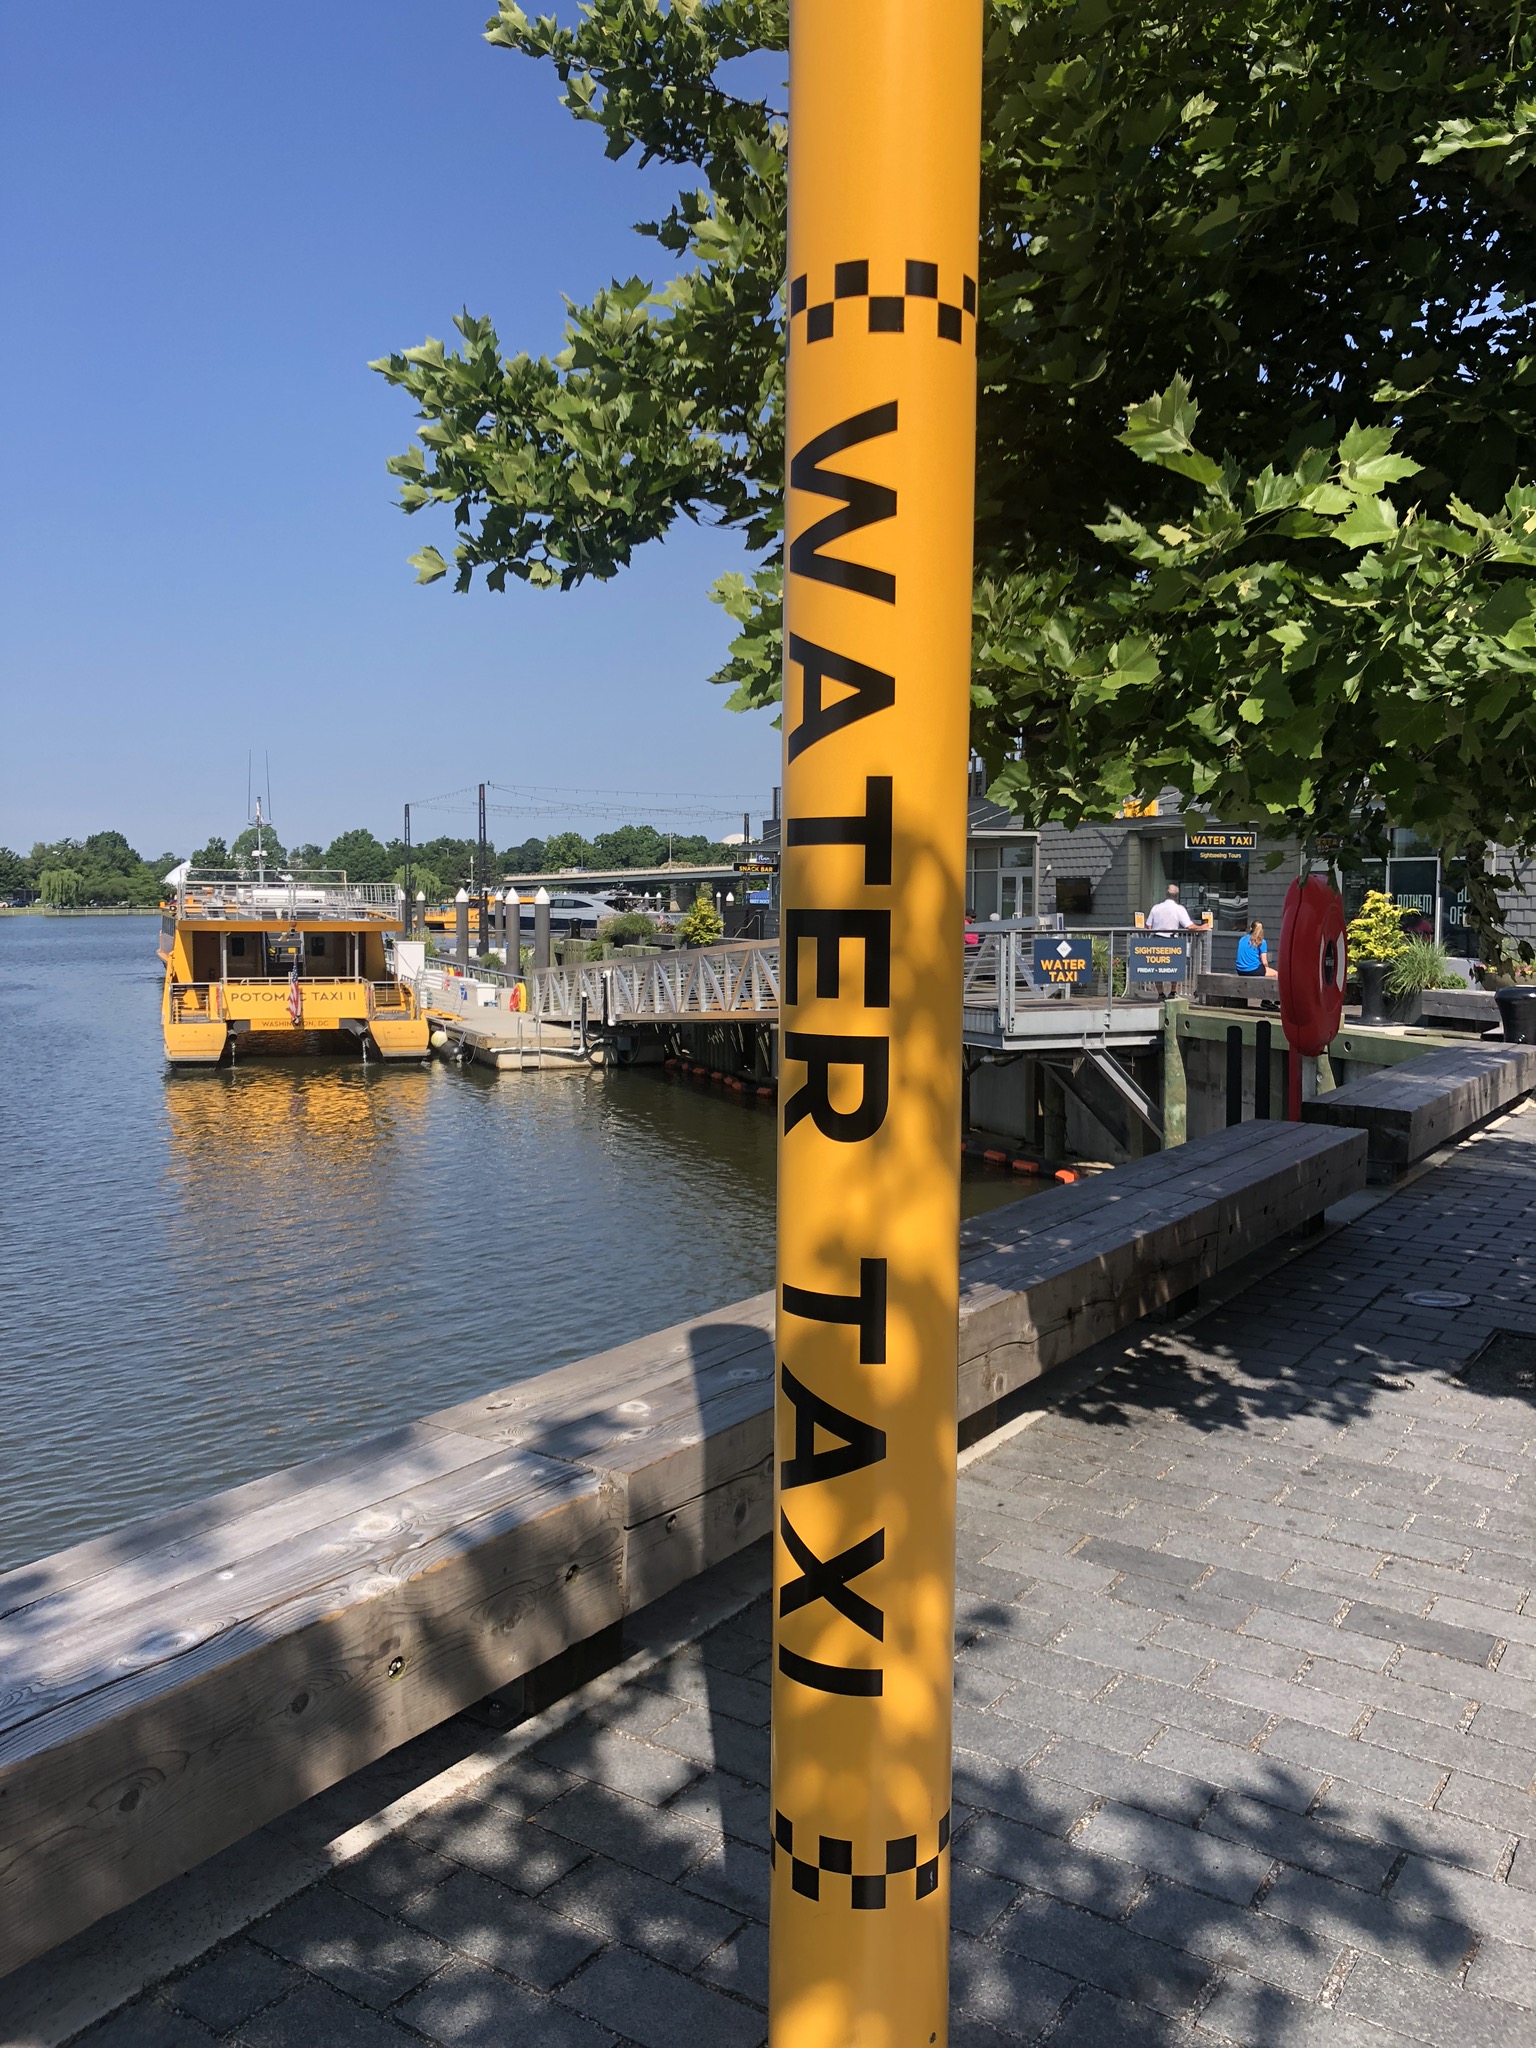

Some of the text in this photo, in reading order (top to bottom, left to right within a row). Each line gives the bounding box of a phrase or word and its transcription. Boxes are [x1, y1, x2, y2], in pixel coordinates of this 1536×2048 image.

[1190, 835, 1253, 846] WATER TAXI
[1134, 946, 1183, 955] SIGHTSEEING
[1145, 955, 1171, 964] TOURS
[1040, 959, 1086, 971] WATER
[1049, 971, 1078, 982] TAXI
[310, 991, 343, 1001] TAXI
[261, 1020, 316, 1028] WASHINON,
[779, 400, 899, 1697] WATER TAXI
